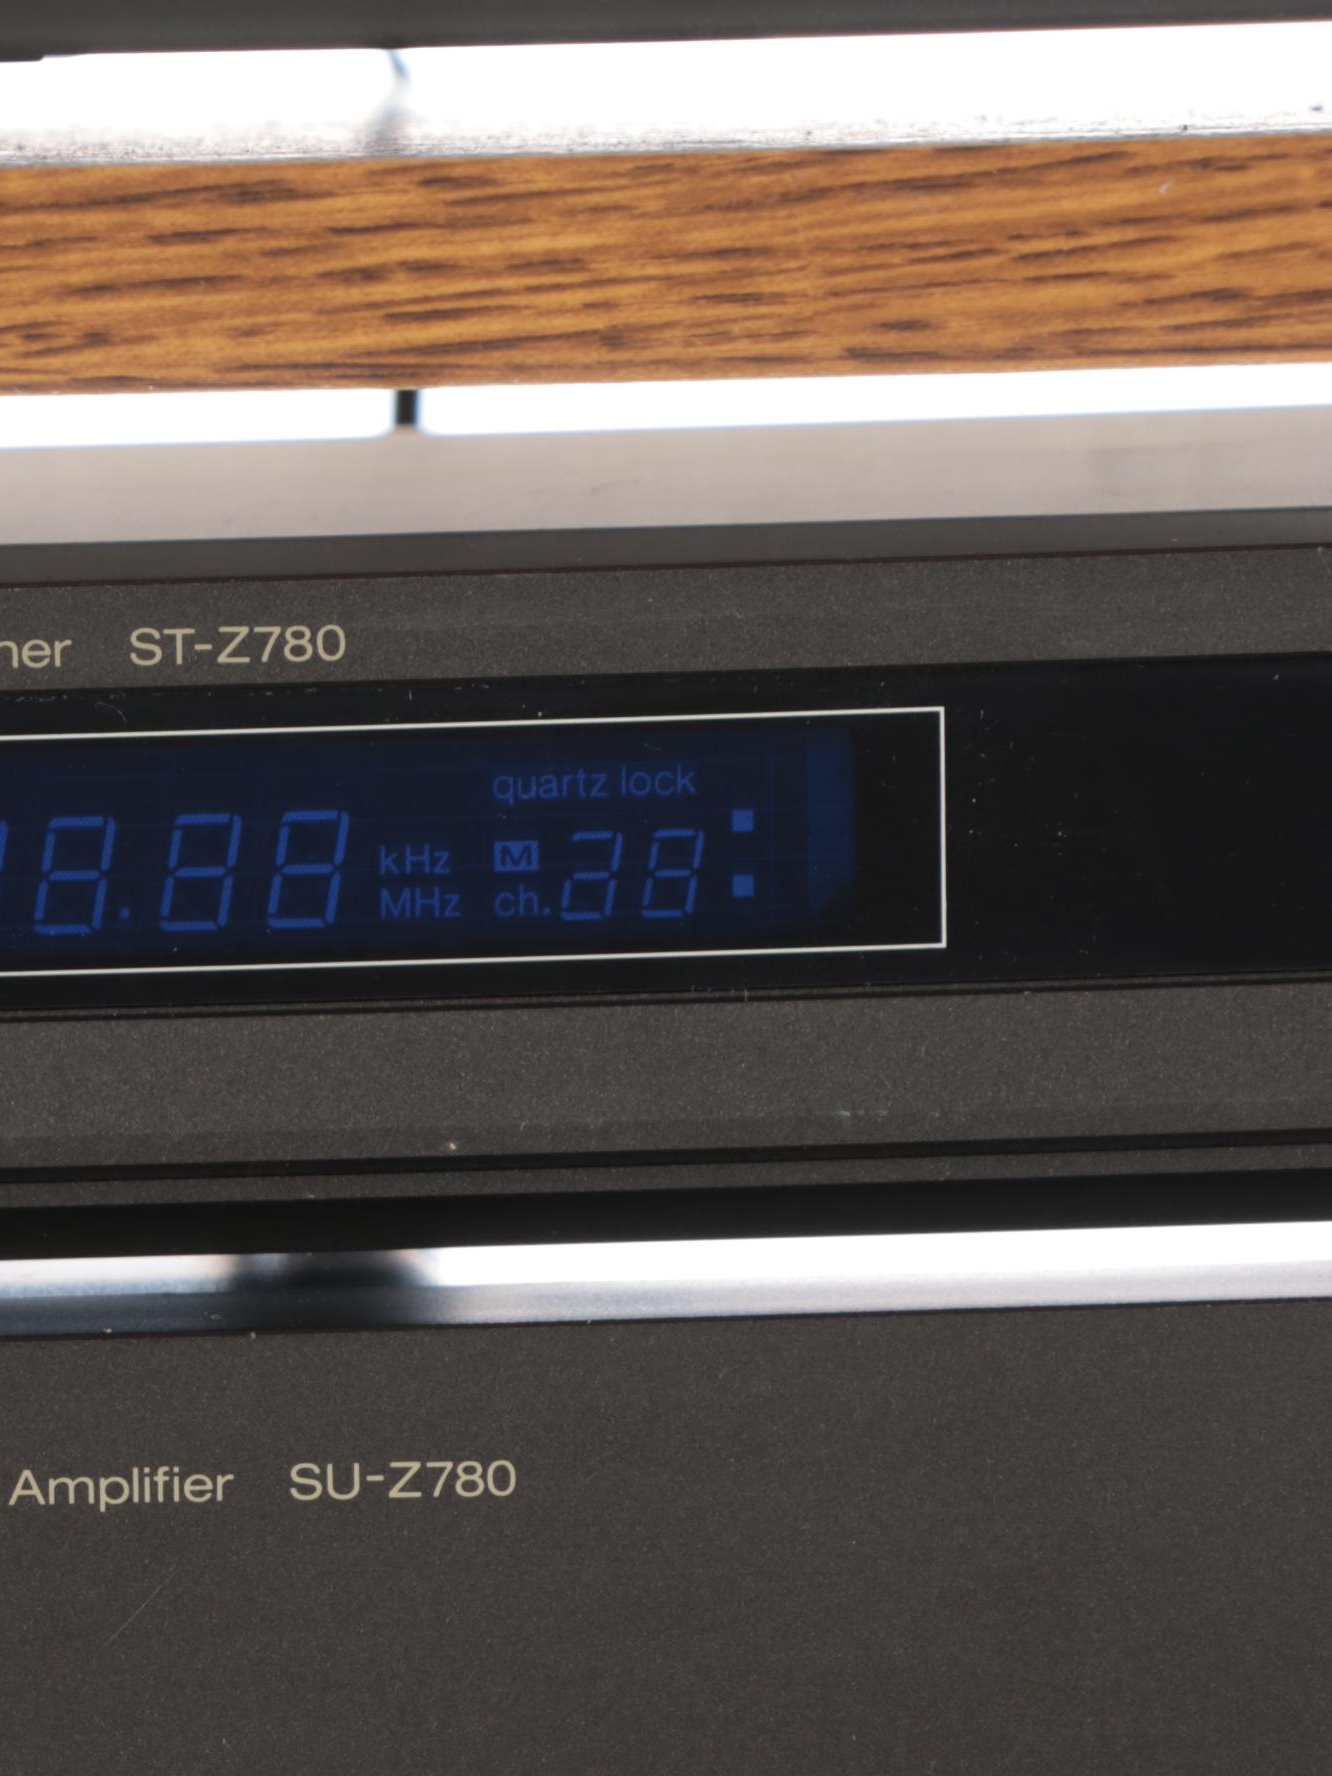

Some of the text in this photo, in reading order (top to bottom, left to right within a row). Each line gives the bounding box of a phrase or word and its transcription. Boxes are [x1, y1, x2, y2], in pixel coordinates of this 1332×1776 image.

[129, 624, 346, 667] ST-Z780
[492, 765, 696, 806] quartz lock
[379, 843, 450, 876] kHz
[379, 886, 461, 919] MHz
[8, 1465, 235, 1513] Amplifier
[289, 1459, 517, 1501] SU-Z780
